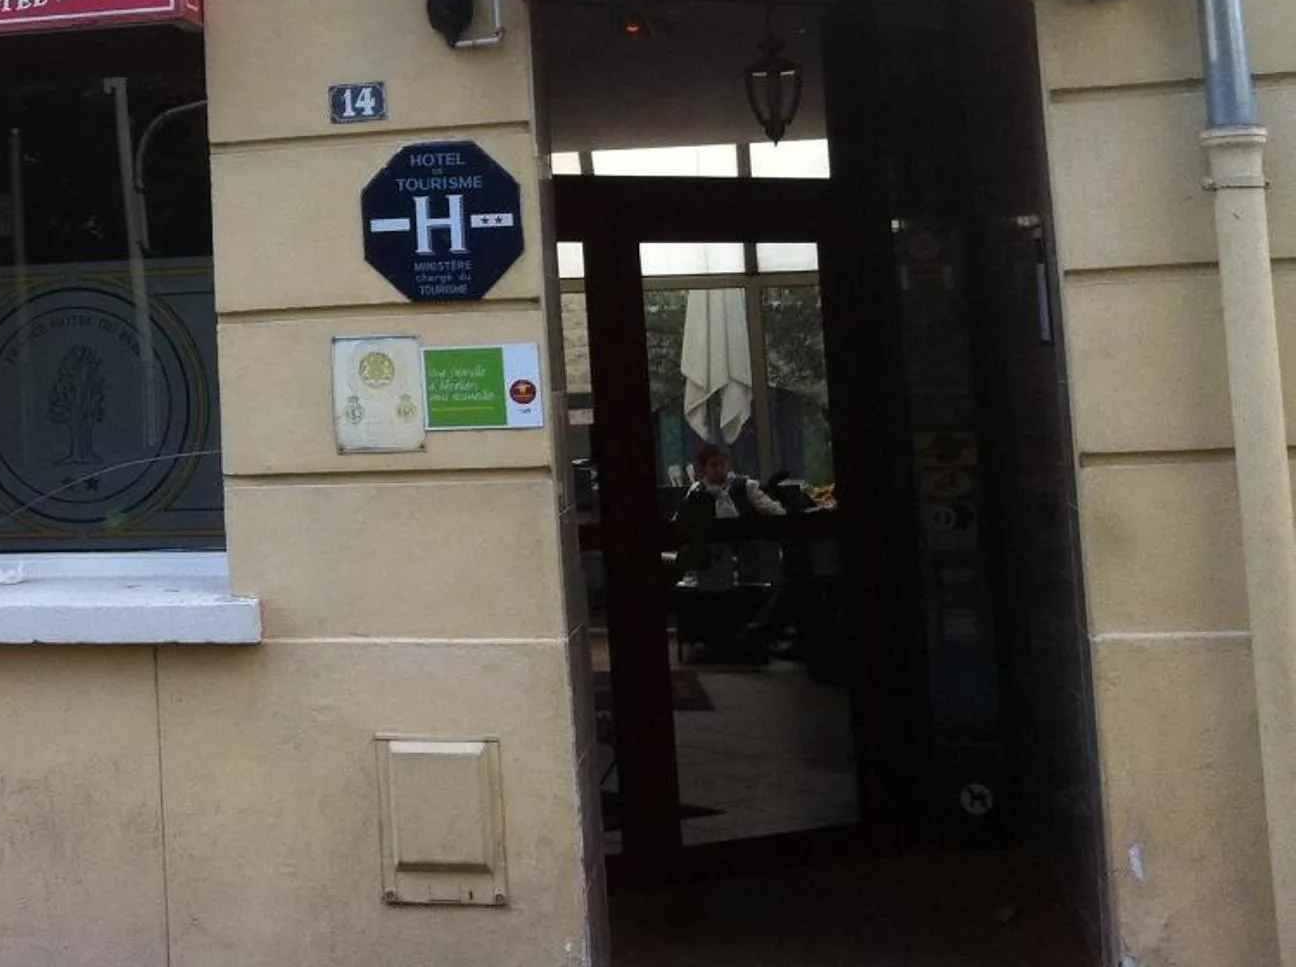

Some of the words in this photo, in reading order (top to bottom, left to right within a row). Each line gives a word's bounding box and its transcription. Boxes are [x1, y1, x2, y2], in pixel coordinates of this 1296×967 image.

[342, 87, 376, 117] 14
[410, 152, 467, 167] HOTEL
[395, 175, 484, 192] TOURISME
[412, 194, 470, 255] H
[419, 283, 469, 296] TOURISME
